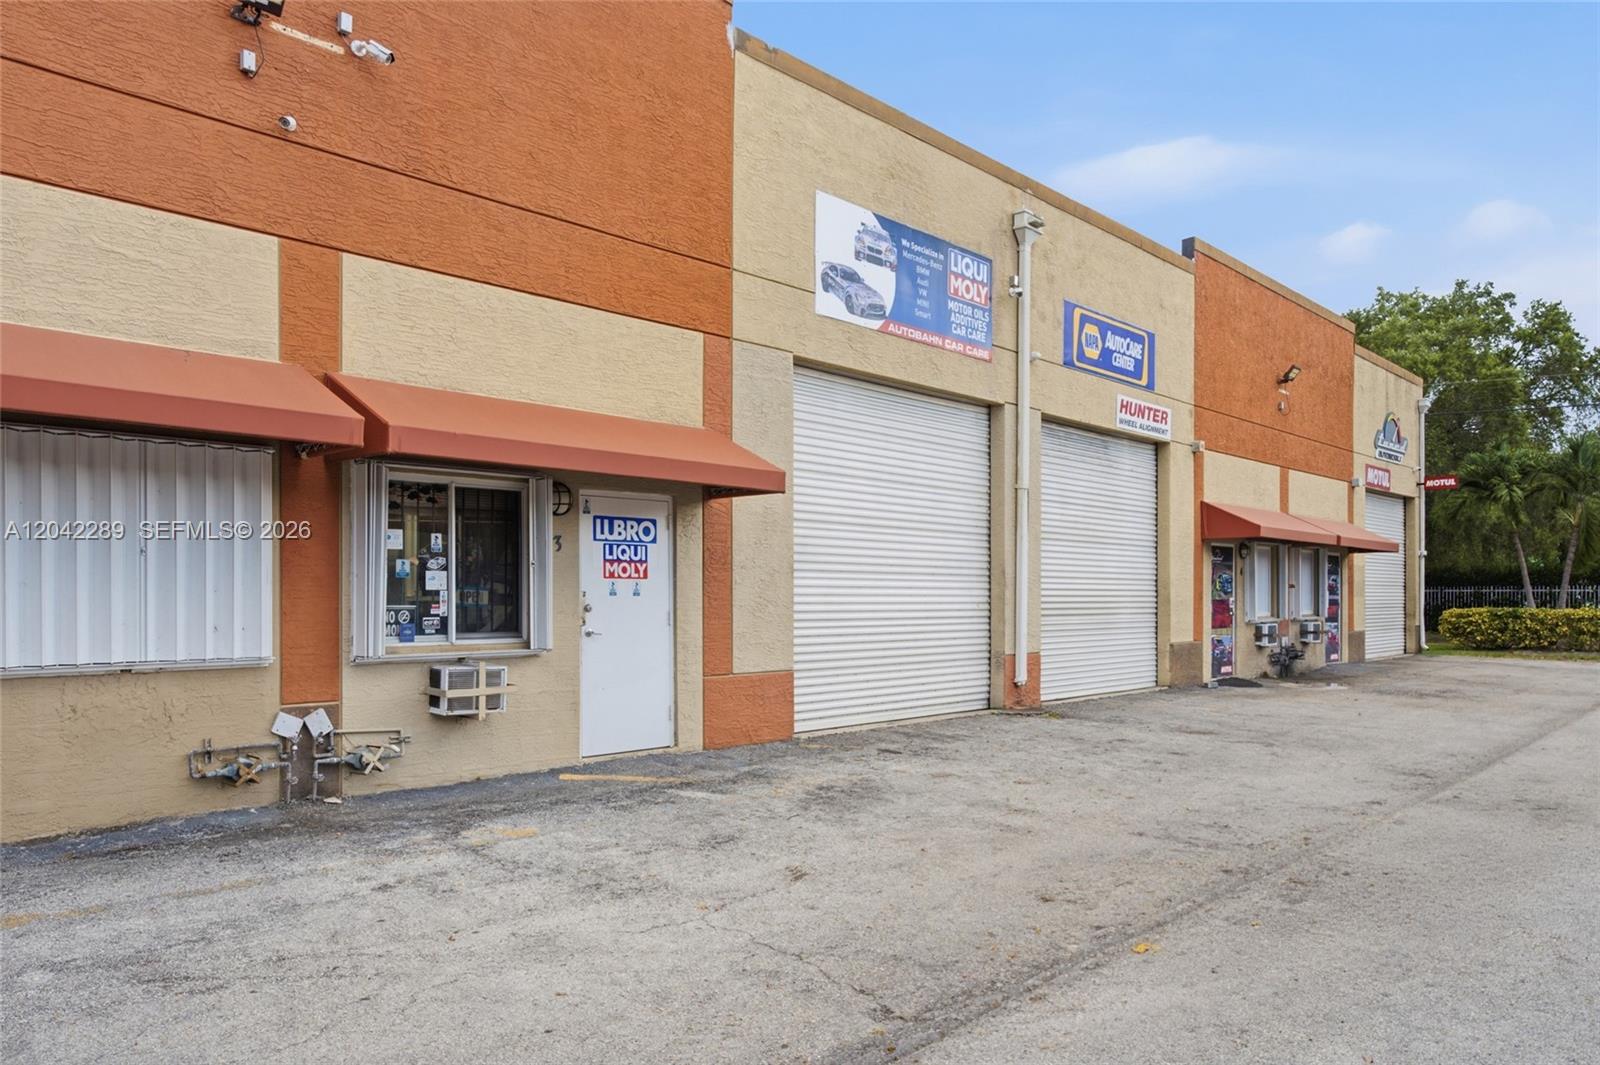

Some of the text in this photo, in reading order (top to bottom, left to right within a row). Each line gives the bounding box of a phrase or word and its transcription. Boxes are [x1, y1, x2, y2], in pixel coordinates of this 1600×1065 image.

[901, 238, 911, 248] We
[911, 241, 938, 258] Specialize
[950, 251, 988, 283] LIQUI
[950, 274, 988, 305] MOLY
[948, 299, 990, 322] MOTOR OILS
[950, 312, 988, 332] ADDITIVES
[888, 323, 990, 360] AUTOBAHN CAR CARE
[952, 323, 986, 343] CAR CARE
[1112, 352, 1135, 372] CENTER
[1120, 399, 1168, 426] HUNTER
[1119, 417, 1168, 436] WHEEL ALIGNMENT
[1367, 467, 1390, 488] MOTUL
[1426, 479, 1456, 487] MOTUL
[595, 518, 656, 542] LUBRO
[605, 545, 646, 561] LIQUI
[605, 562, 647, 578] MOLY
